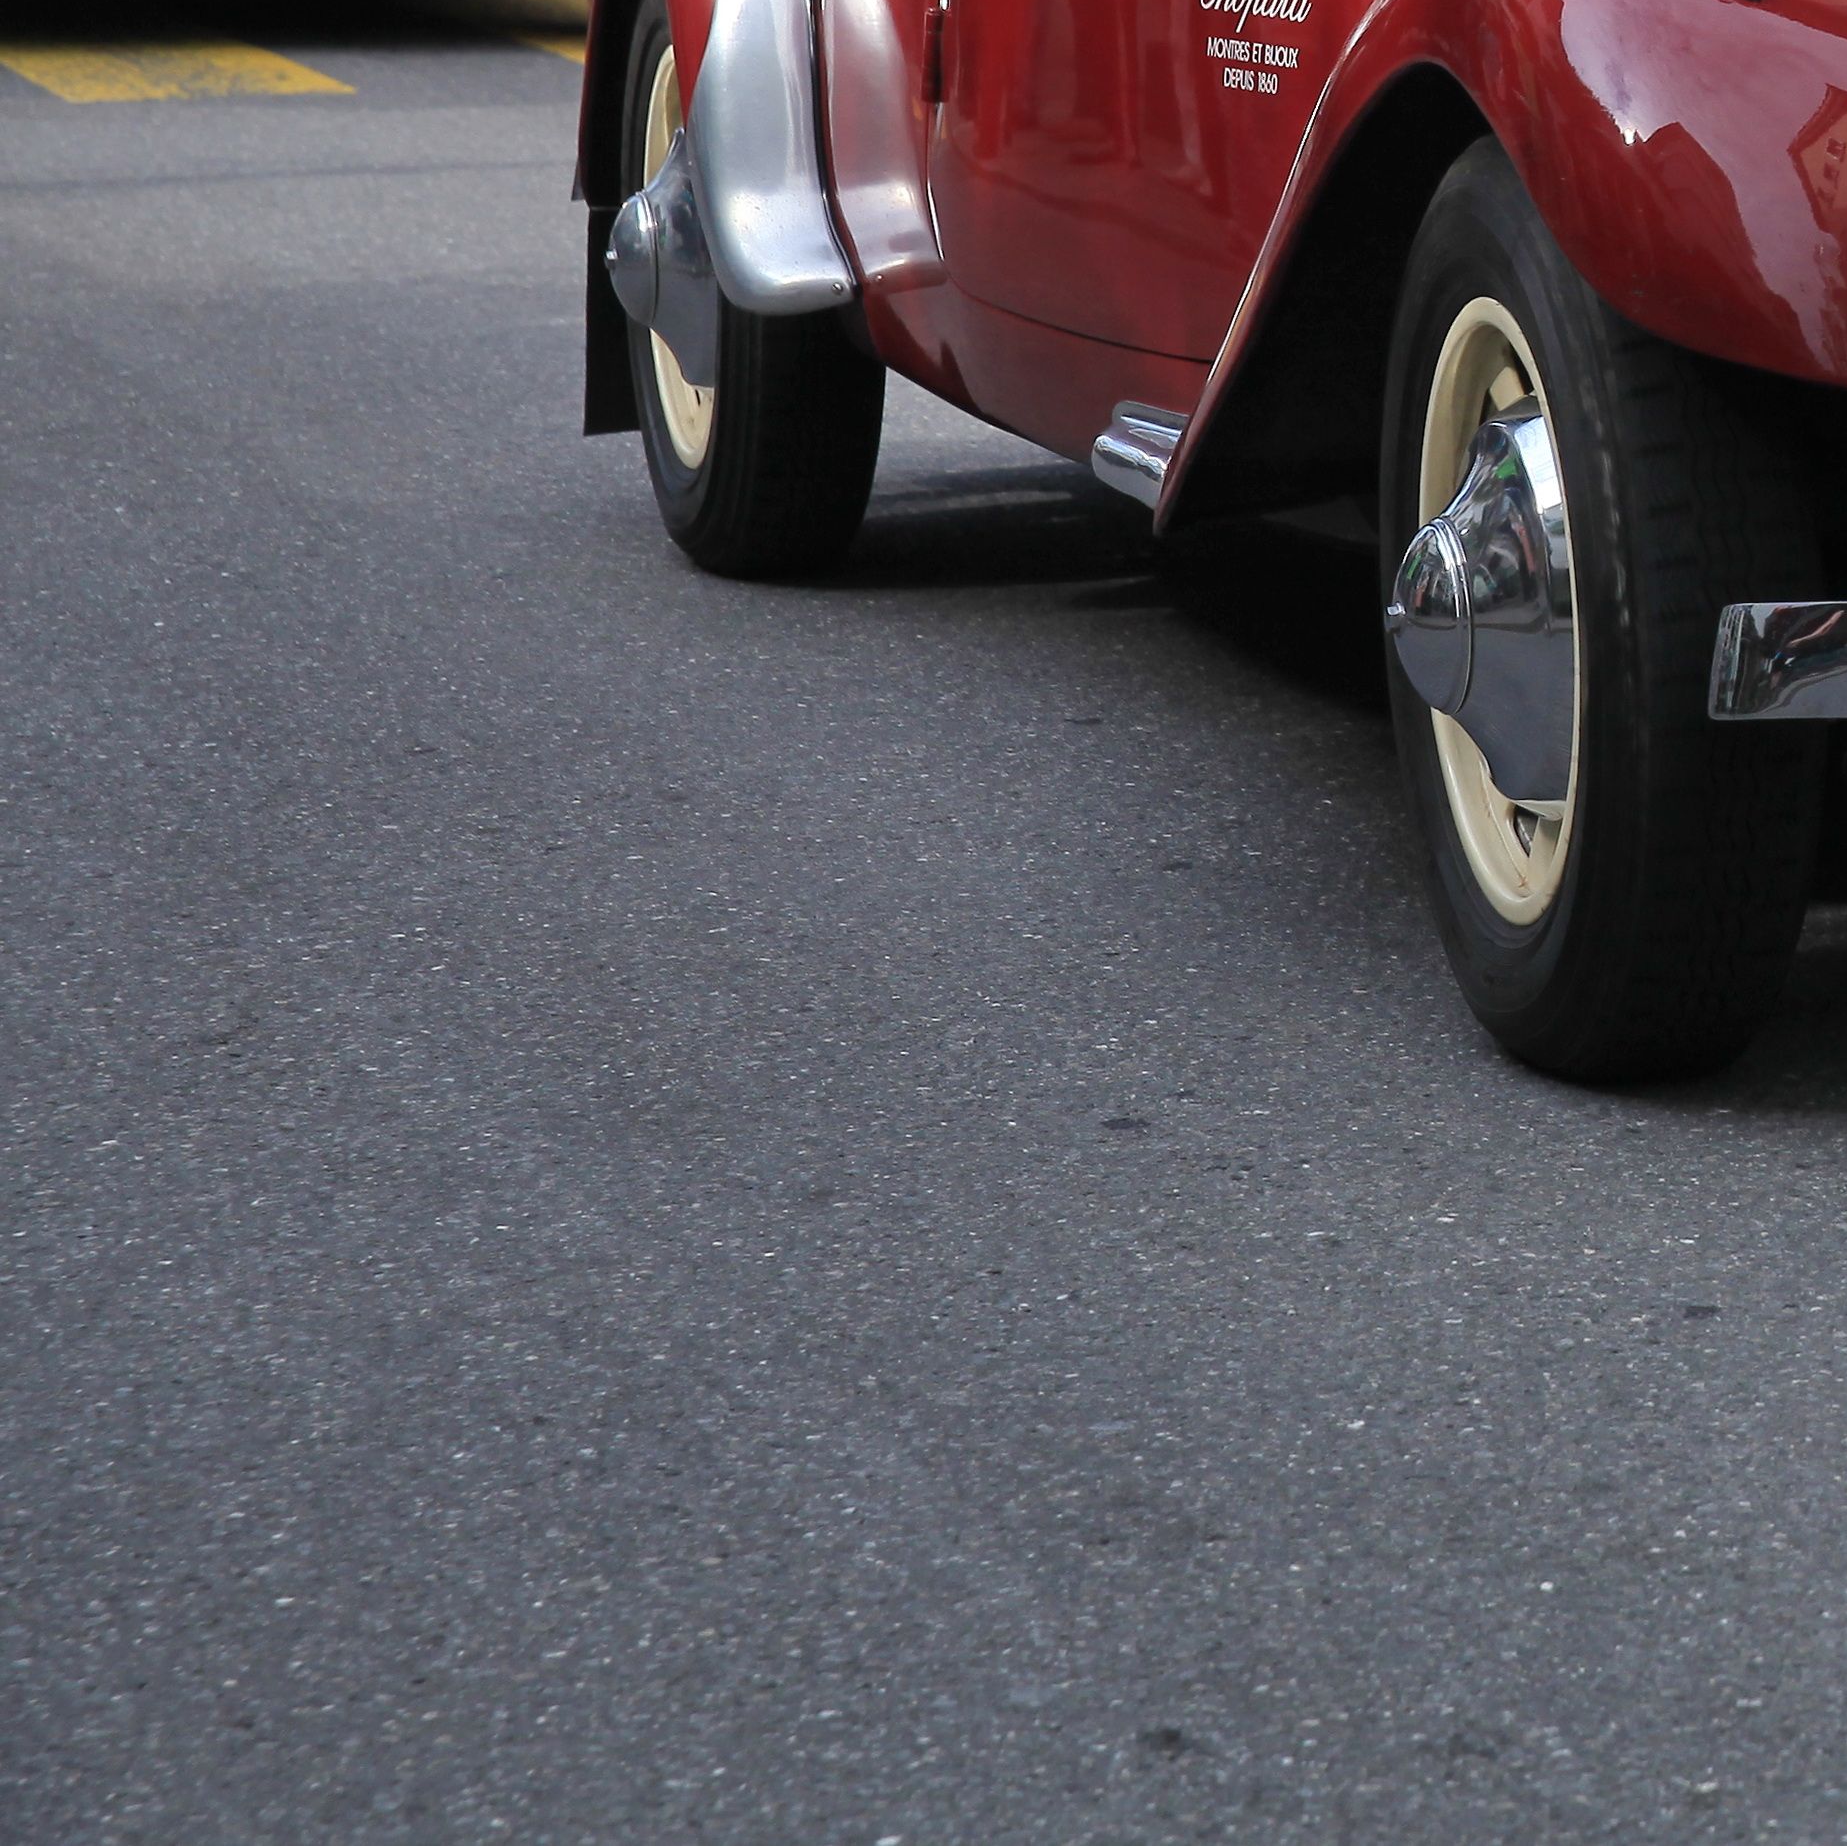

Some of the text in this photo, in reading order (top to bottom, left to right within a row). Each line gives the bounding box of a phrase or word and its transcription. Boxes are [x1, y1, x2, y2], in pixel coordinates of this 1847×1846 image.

[1207, 36, 1299, 68] MONTRES ET BIJOUX
[1223, 67, 1279, 94] DEPUIS 1860
